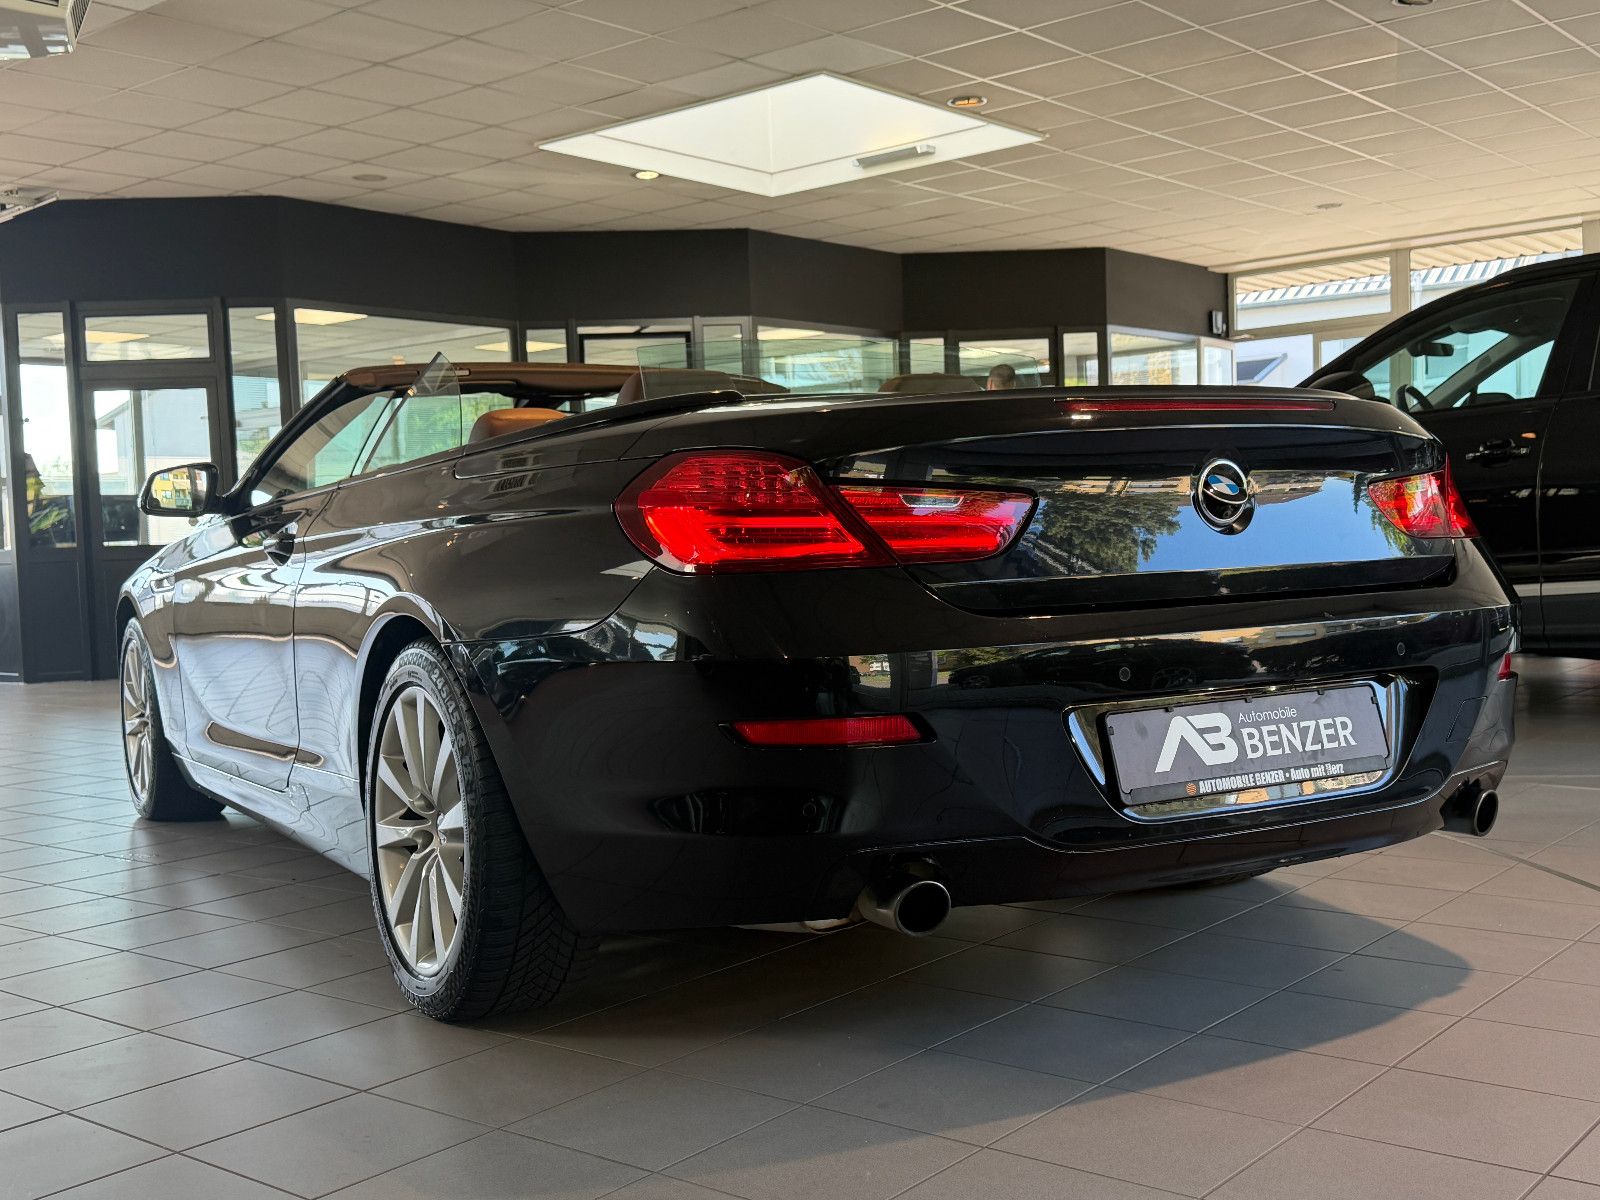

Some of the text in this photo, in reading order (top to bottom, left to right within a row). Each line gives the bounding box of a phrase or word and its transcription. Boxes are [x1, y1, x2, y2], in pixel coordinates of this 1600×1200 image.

[1238, 706, 1298, 723] Automobile
[1240, 716, 1358, 759] BENZER
[1199, 773, 1256, 794] AUTOMOBILE
[1255, 769, 1286, 786] BENZER
[1290, 767, 1311, 781] Auto
[1311, 764, 1326, 777] mit
